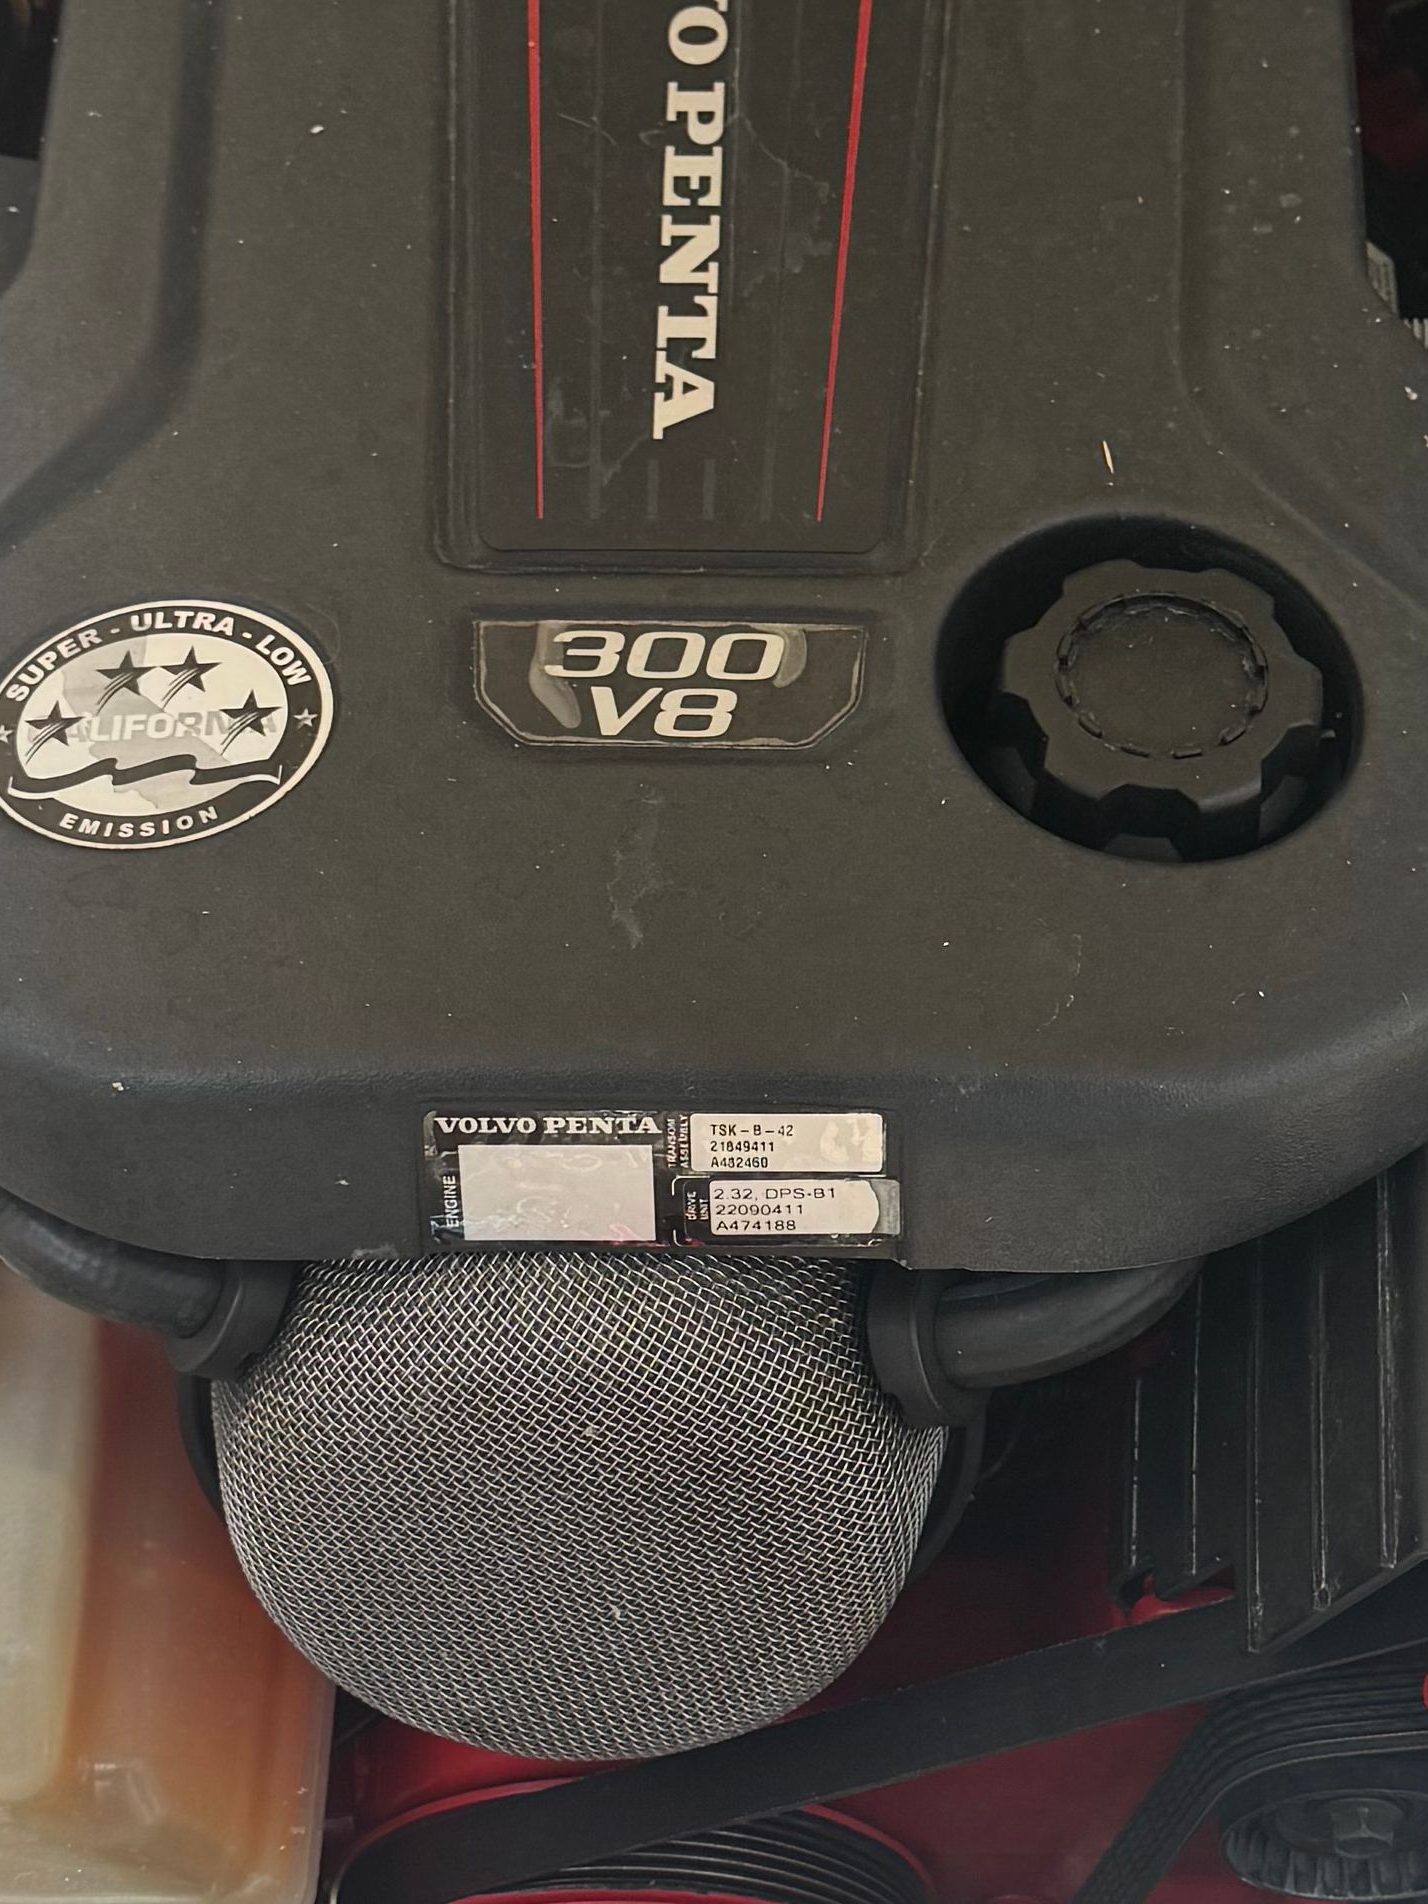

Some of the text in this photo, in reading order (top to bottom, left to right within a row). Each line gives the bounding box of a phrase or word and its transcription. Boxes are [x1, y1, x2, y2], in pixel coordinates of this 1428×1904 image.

[652, 82, 726, 440] PENTA
[6, 611, 311, 702] SUPER ULTRA LOW
[544, 630, 785, 681] 300
[590, 686, 738, 738] V8
[60, 806, 218, 838] EMISSION
[434, 1117, 662, 1134] VOLVO PENTA
[443, 1176, 458, 1227] ENGINE
[715, 1205, 803, 1215] 22090411
[716, 1220, 796, 1230] A474188
